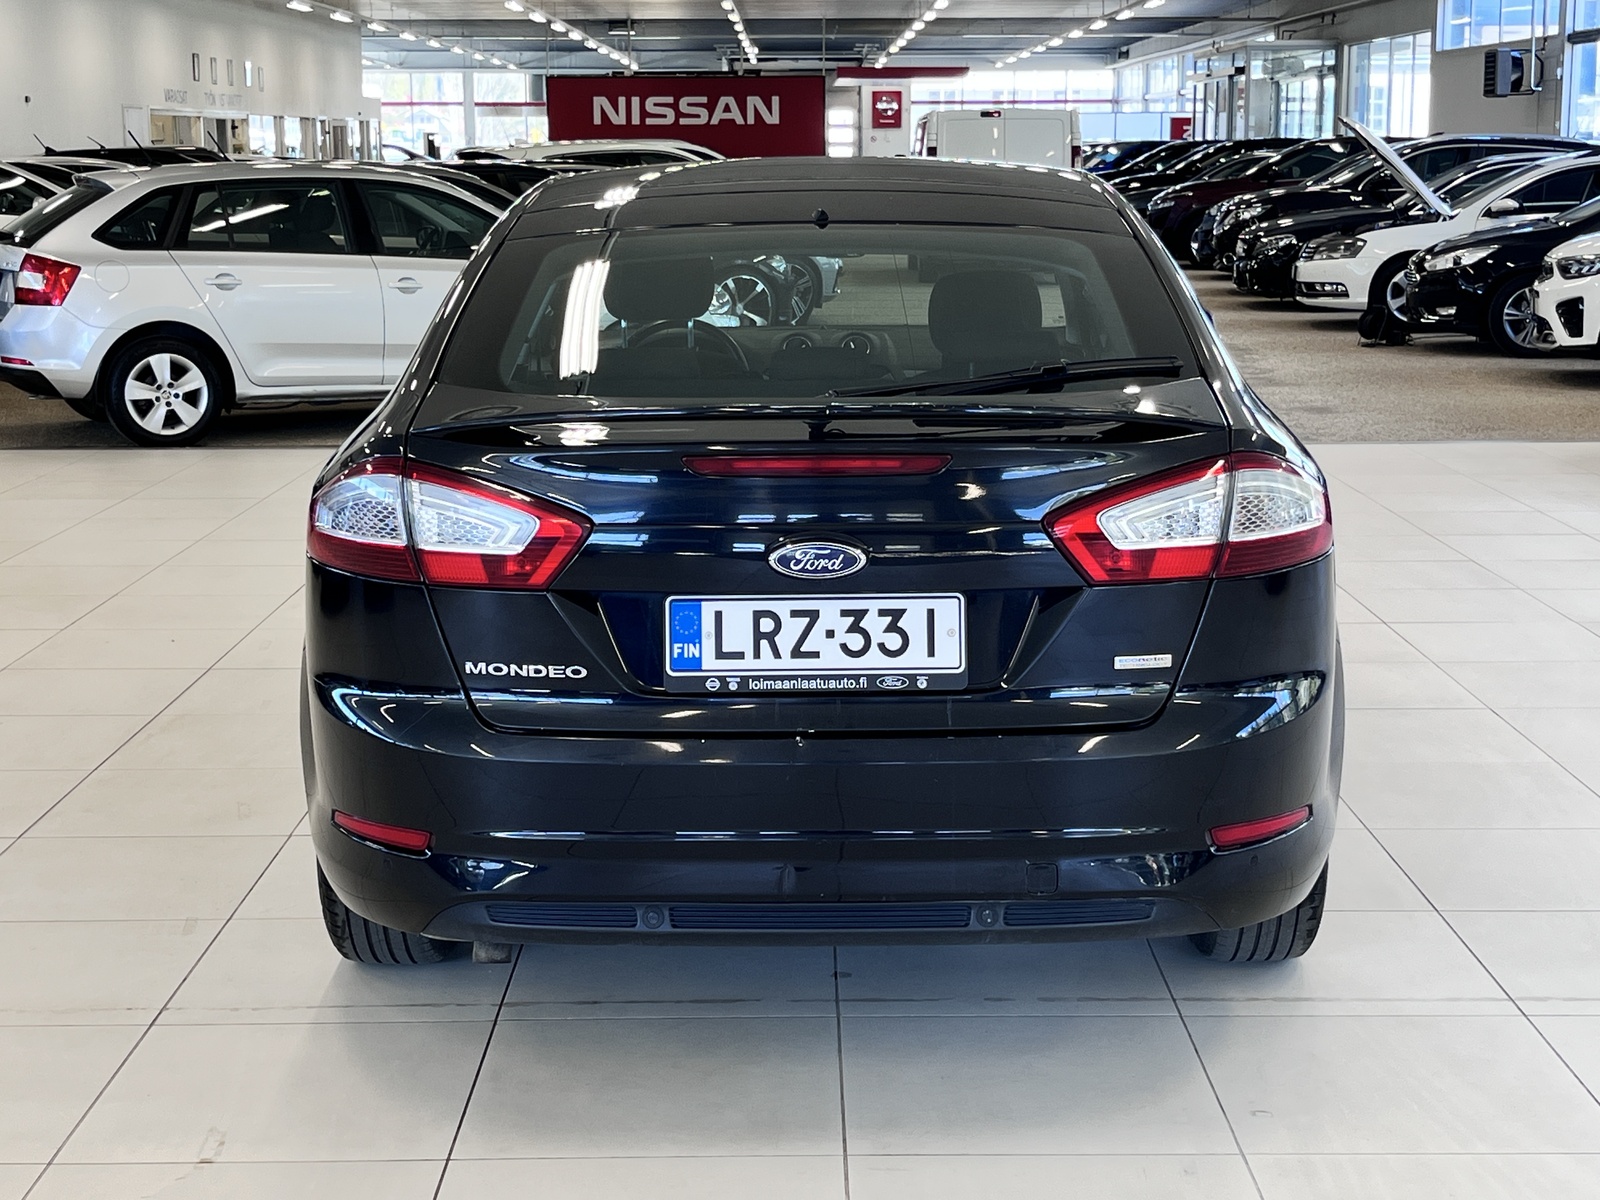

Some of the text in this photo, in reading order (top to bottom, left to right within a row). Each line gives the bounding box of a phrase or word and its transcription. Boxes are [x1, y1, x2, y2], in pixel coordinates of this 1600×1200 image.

[593, 96, 780, 125] NISSAN
[790, 549, 844, 571] Ford
[673, 643, 700, 658] FIN
[465, 661, 588, 679] MONDEO
[748, 677, 868, 691] loimaanlaatuauto.fi
